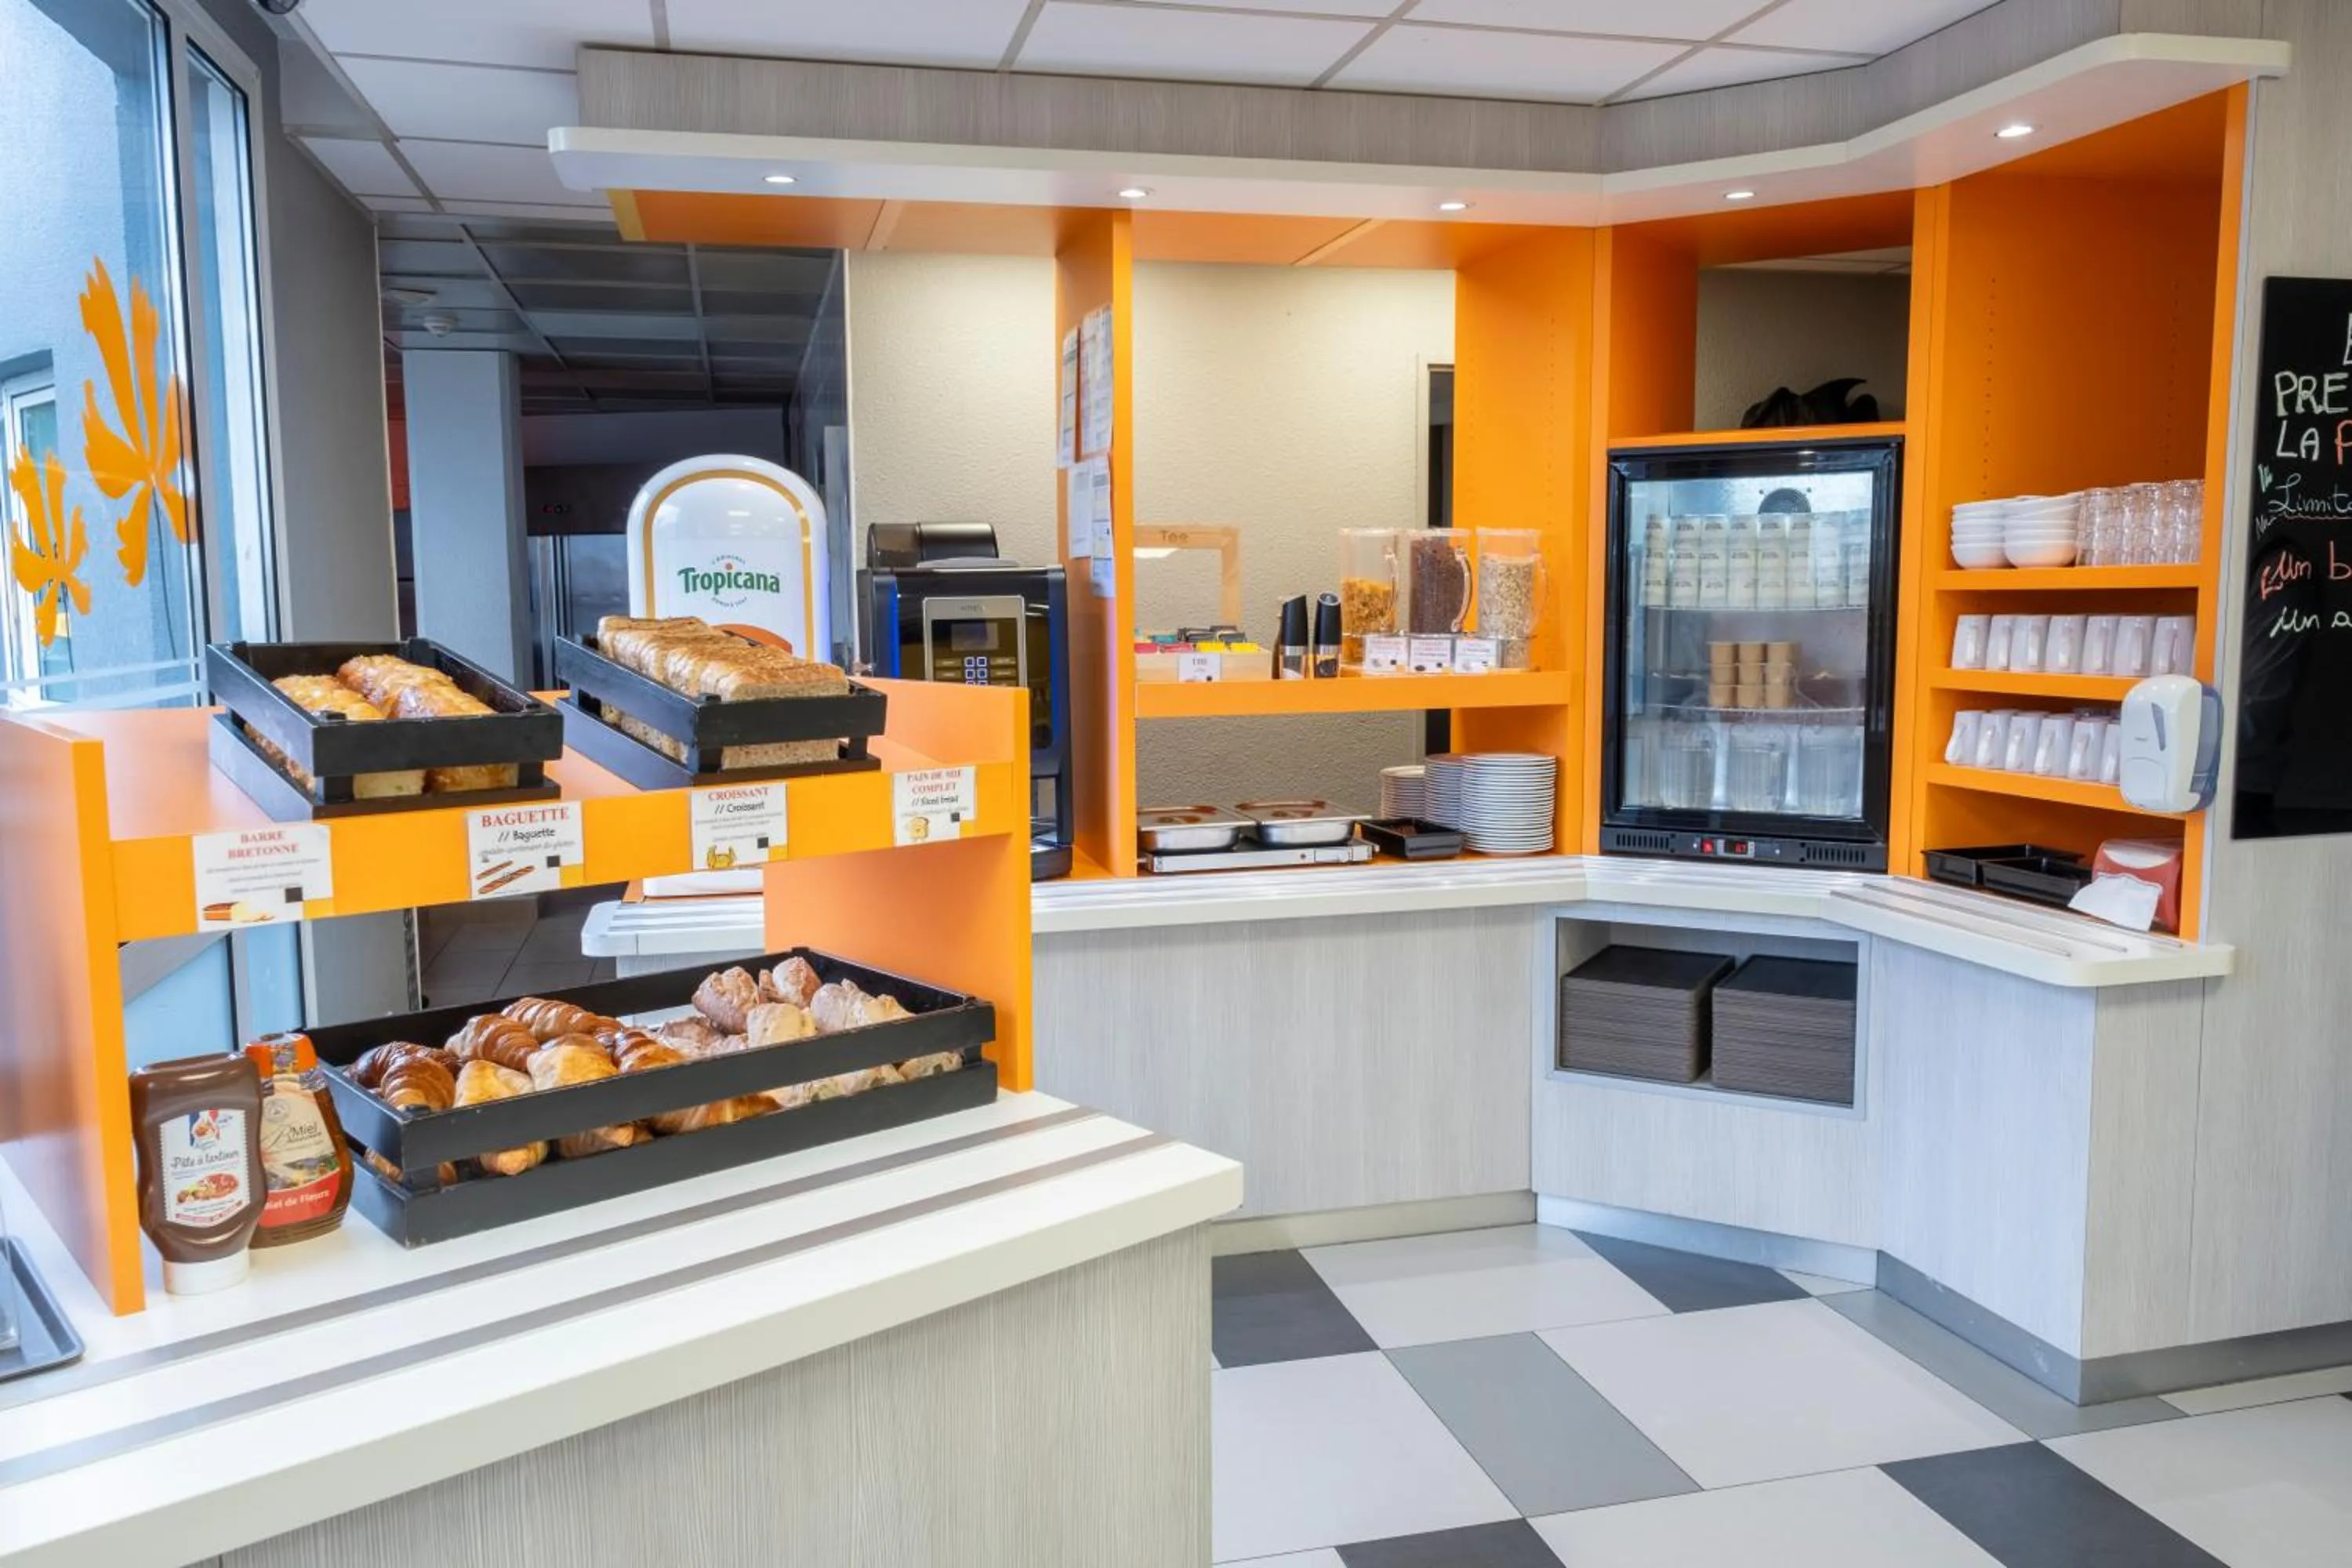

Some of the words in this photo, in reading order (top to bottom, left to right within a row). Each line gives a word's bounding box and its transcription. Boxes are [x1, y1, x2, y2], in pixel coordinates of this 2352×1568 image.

[2274, 371, 2350, 417] PRE
[2276, 419, 2320, 461] LA
[677, 562, 780, 596] Tropicana
[708, 786, 769, 801] CROISSANT
[912, 782, 956, 794] COMPLET
[727, 801, 765, 813] Croissant
[481, 807, 570, 828] BAGUETTE
[240, 829, 286, 844] BARRE
[513, 827, 556, 842] Baguette
[228, 843, 299, 860] BRETONNE
[284, 1197, 297, 1207] de
[299, 1189, 331, 1204] Fleurs
